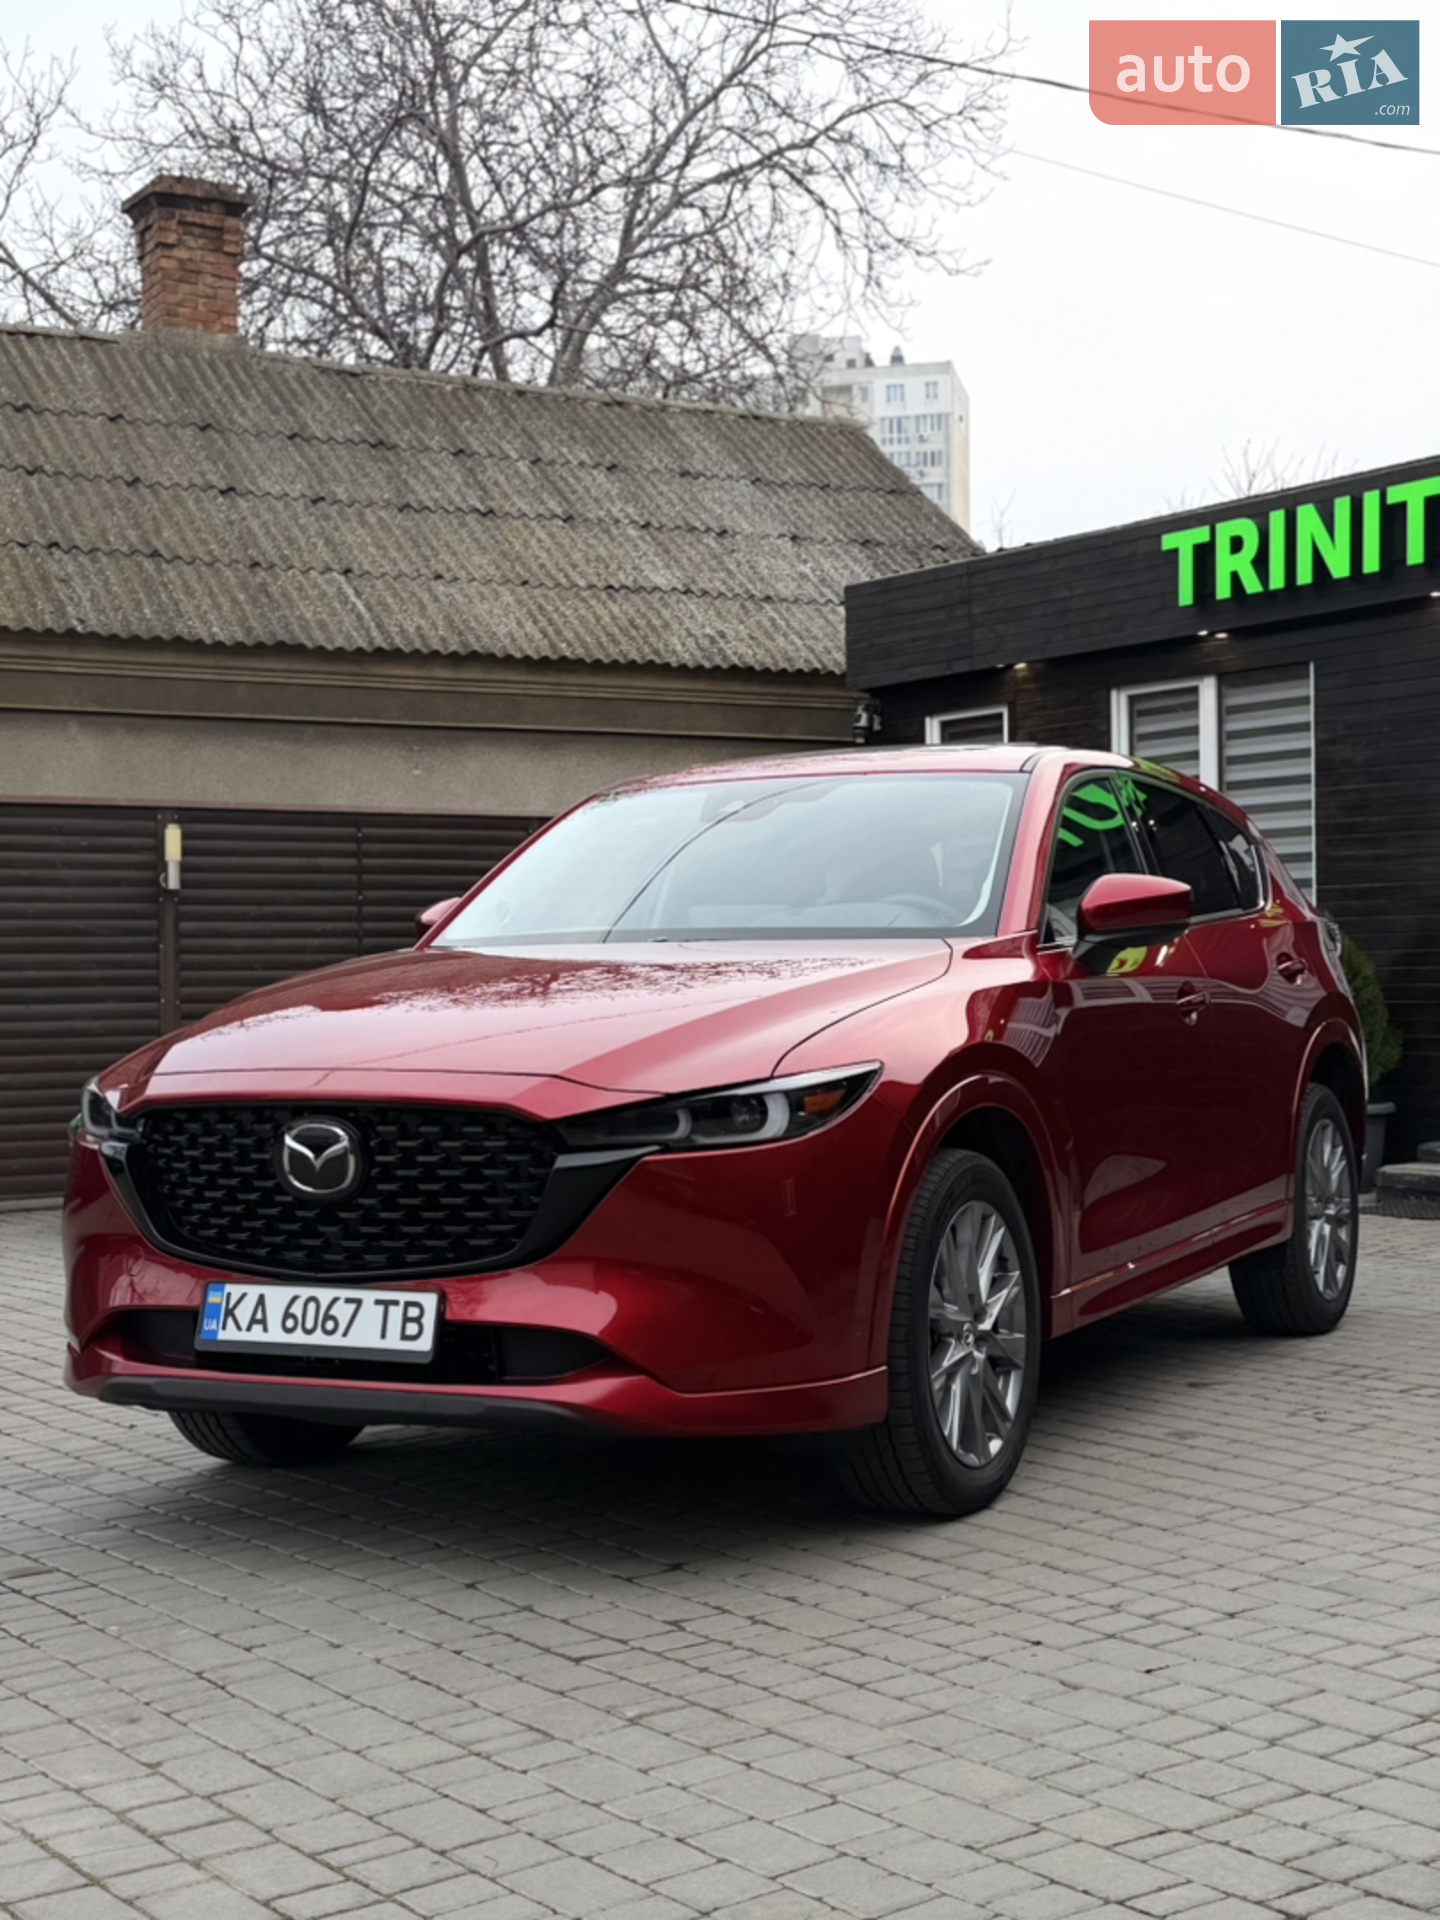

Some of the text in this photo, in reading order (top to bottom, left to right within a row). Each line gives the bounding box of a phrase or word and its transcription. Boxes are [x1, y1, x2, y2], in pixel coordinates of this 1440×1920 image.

[1161, 475, 1440, 607] TRINIT
[203, 1318, 218, 1331] UA
[221, 1291, 425, 1342] KA 6067 TB
